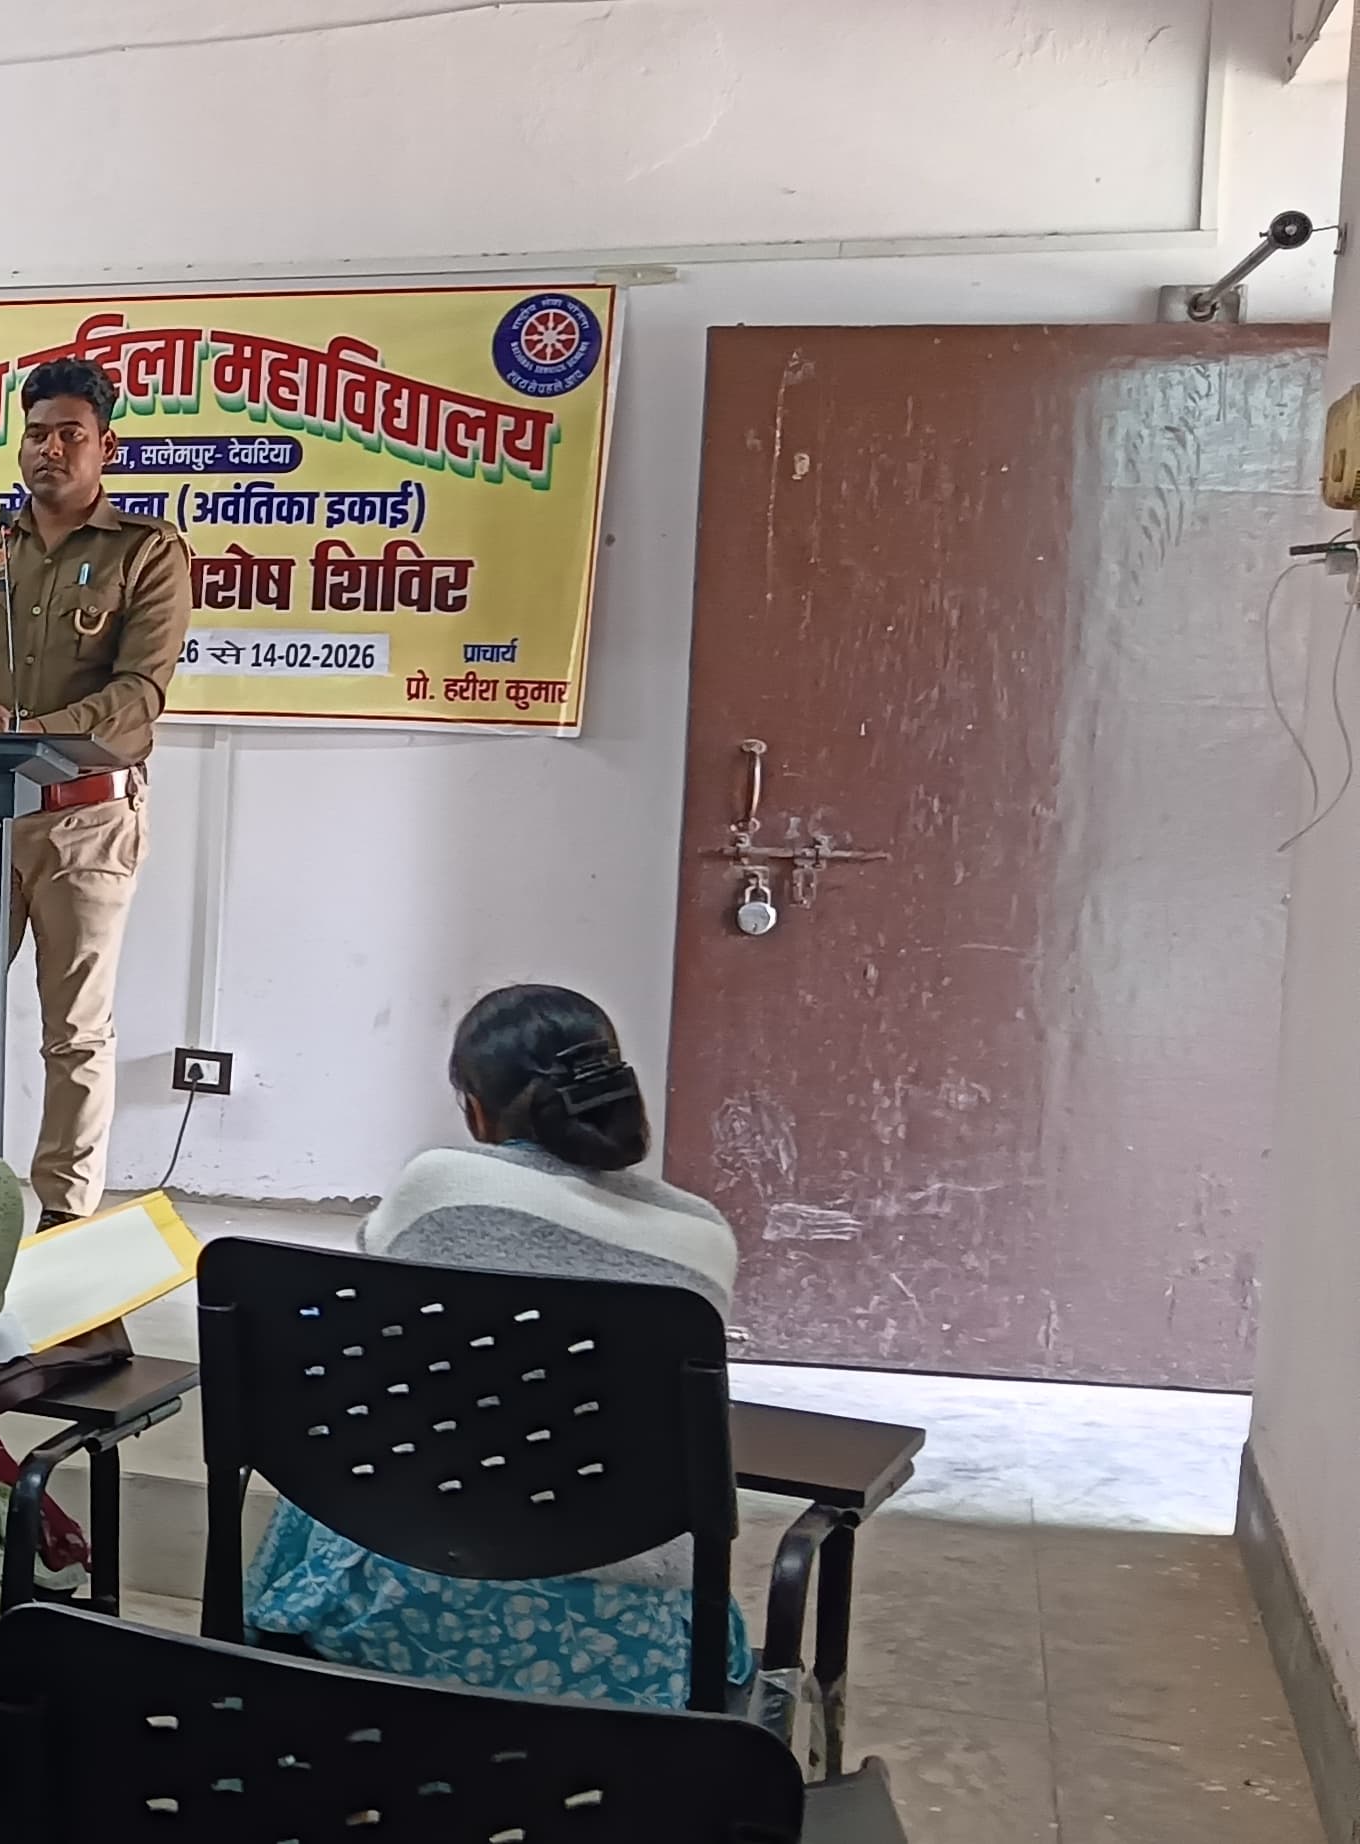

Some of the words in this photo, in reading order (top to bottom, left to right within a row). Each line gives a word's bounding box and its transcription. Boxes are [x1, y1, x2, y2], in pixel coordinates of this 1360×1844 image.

[210, 330, 553, 471] महाविद्यालय
[228, 438, 292, 465] देवरिया
[177, 481, 319, 532] (अवंतिका
[325, 480, 426, 533] इकाई)
[310, 540, 475, 613] शिविर
[206, 640, 246, 665] से
[251, 642, 375, 669] 14-02-2026
[464, 638, 519, 663] प्राचार्य
[406, 670, 435, 701] प्रो.
[443, 671, 499, 702] हरीश
[505, 679, 571, 710] कुमार
